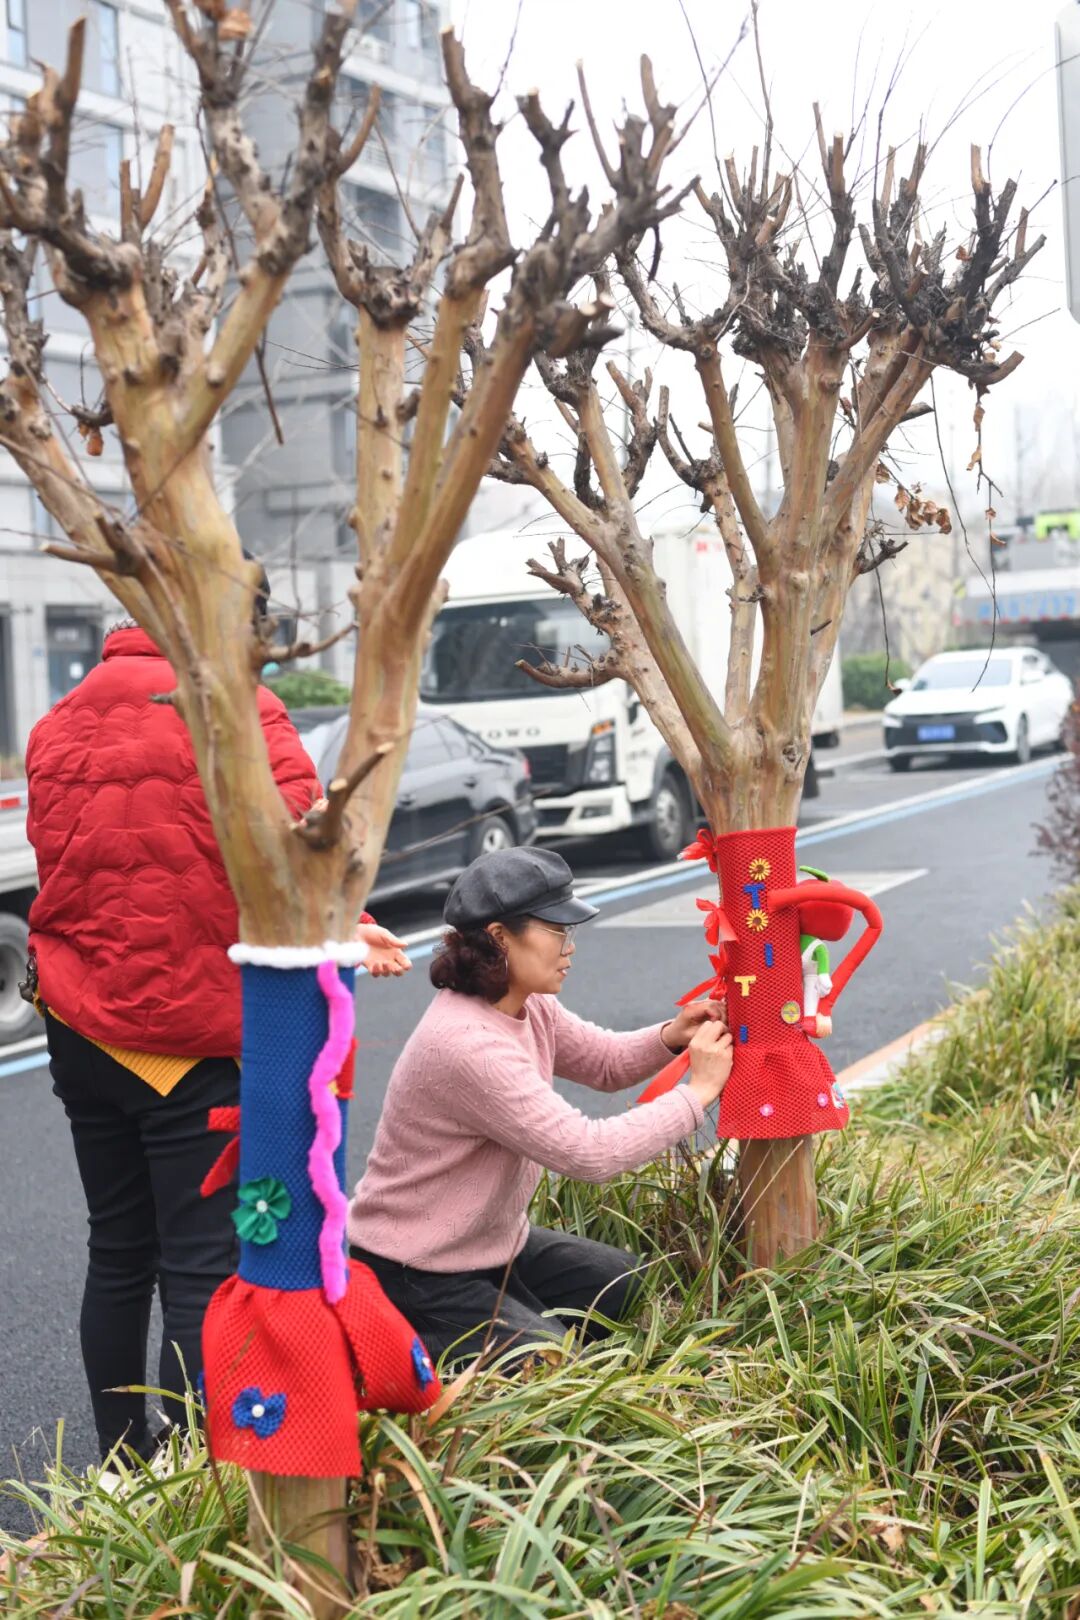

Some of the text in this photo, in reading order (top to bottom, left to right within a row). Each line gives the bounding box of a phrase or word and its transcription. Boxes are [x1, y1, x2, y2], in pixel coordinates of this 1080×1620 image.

[477, 727, 541, 740] OWO
[743, 883, 765, 909] T
[734, 975, 757, 997] T
